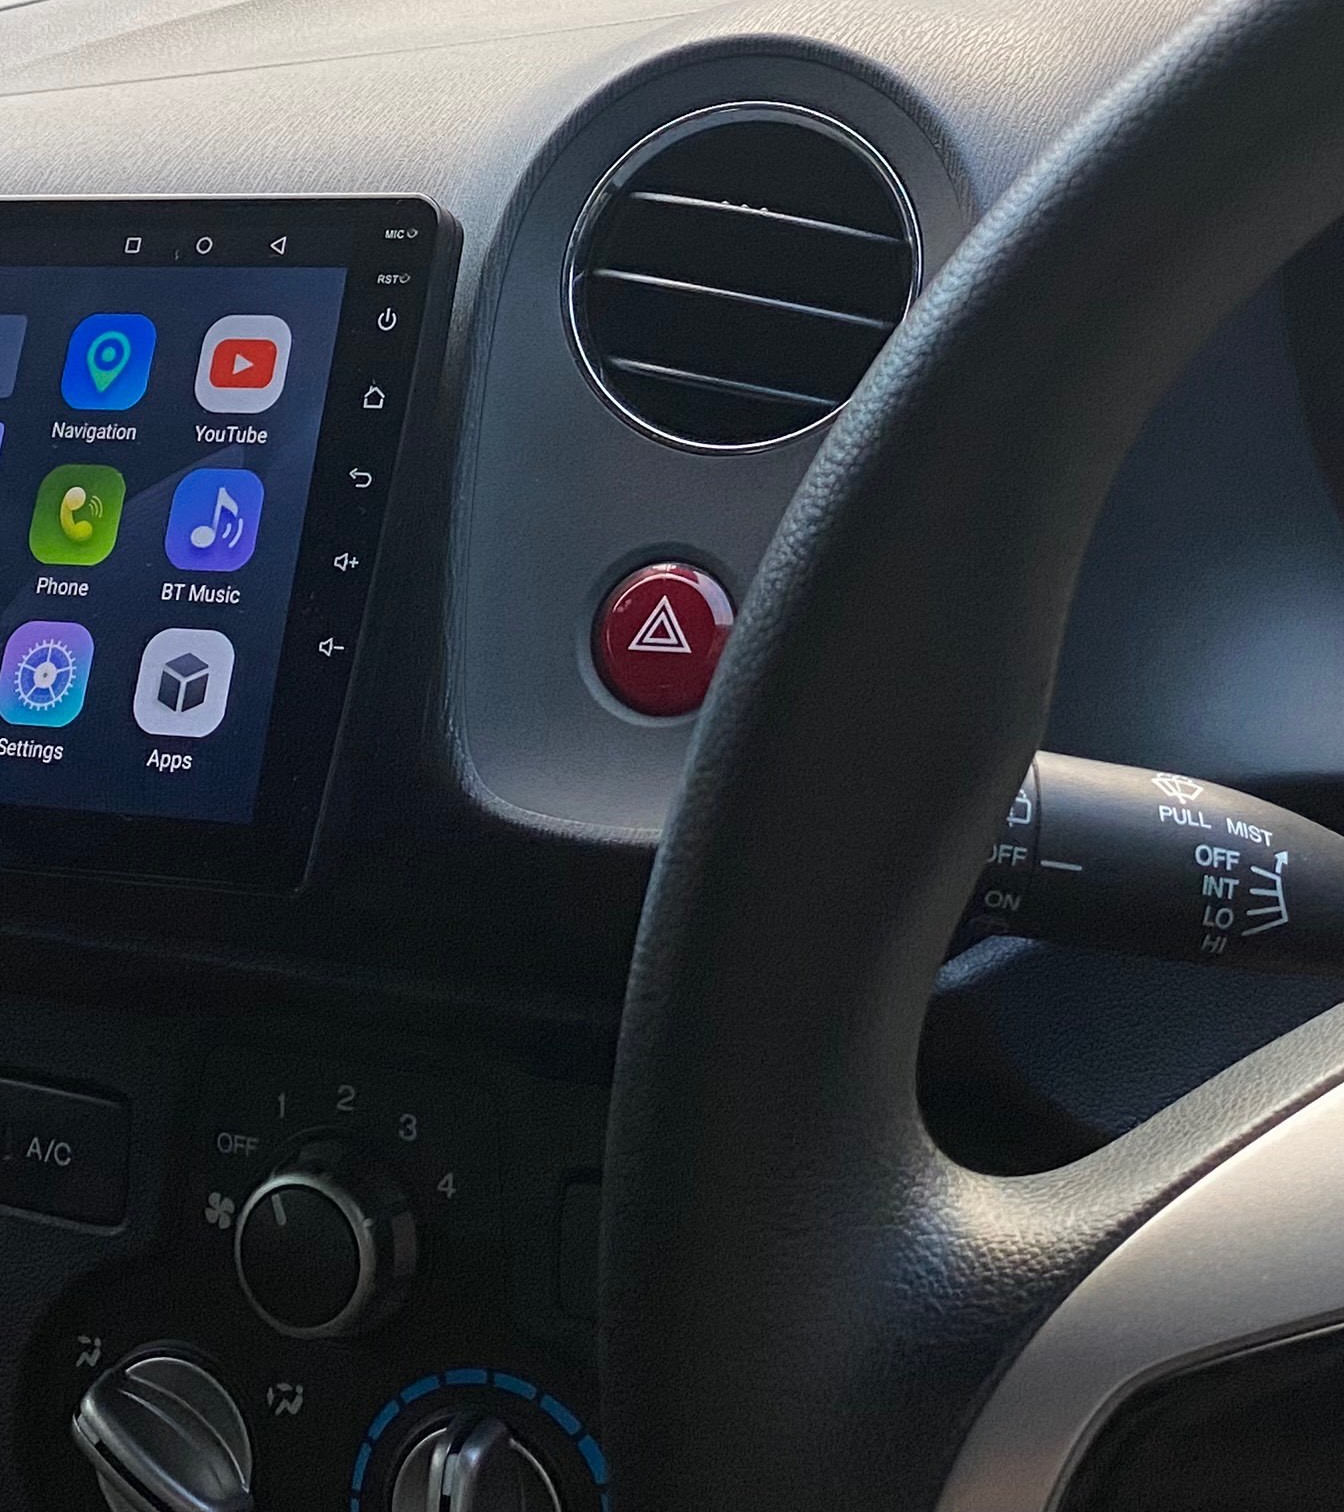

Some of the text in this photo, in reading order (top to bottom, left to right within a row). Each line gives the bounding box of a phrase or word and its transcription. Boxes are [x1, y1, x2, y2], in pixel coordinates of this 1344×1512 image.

[385, 229, 404, 239] MIC
[377, 274, 399, 285] RST
[52, 421, 137, 445] Navigation
[194, 424, 268, 445] YouTube
[36, 577, 89, 597] Phone
[161, 583, 241, 604] BT Music
[146, 749, 193, 773] Apps
[1159, 804, 1273, 847] PULL MIST
[1195, 844, 1240, 870] OFF
[1202, 874, 1240, 900] INT
[984, 890, 1021, 912] ON
[1202, 907, 1235, 930] LO
[1201, 935, 1228, 954] HI
[277, 1092, 286, 1118] 1
[336, 1085, 356, 1111] 2
[398, 1113, 418, 1141] 3
[26, 1135, 72, 1168] A/C
[216, 1132, 258, 1157] OFF
[436, 1171, 455, 1199] 4
